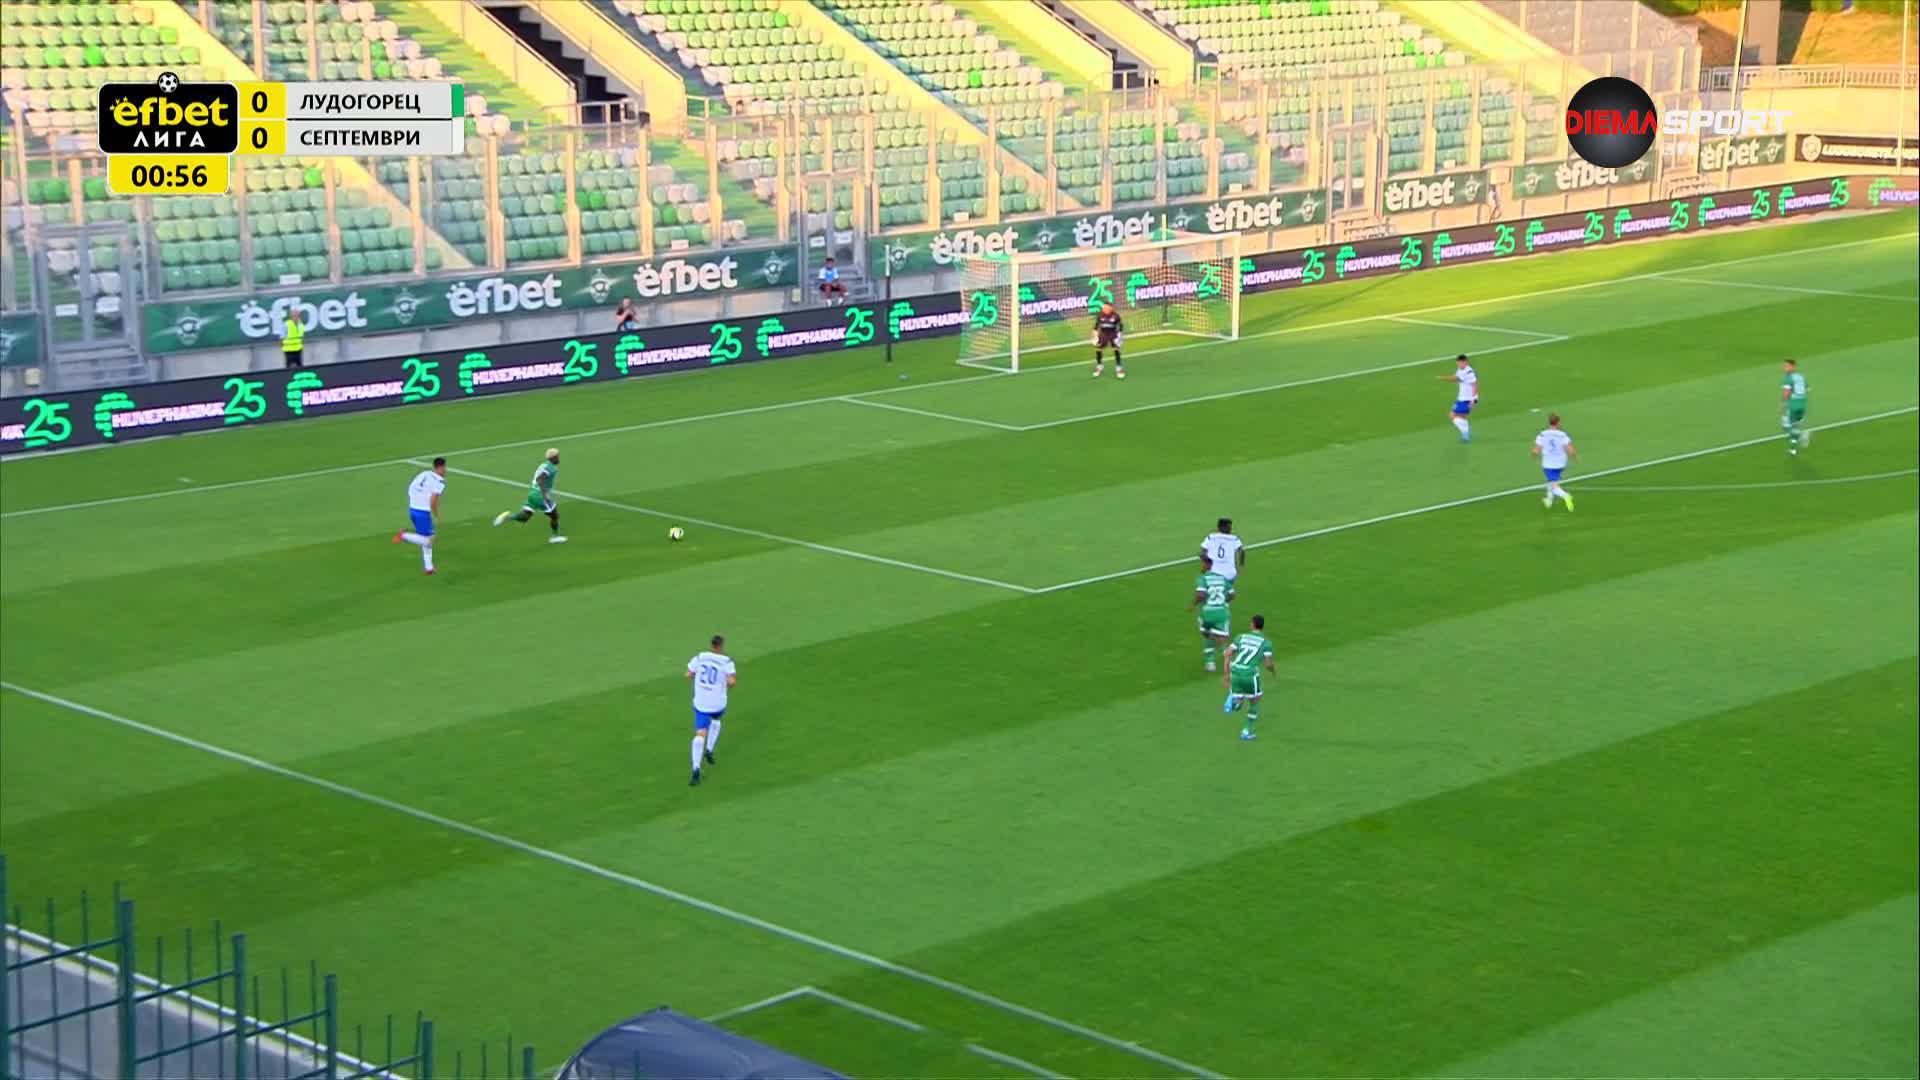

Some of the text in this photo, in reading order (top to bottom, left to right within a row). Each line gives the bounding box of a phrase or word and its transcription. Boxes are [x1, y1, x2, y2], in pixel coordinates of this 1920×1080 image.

[1385, 176, 1456, 212] efbet
[1752, 190, 1771, 217] 25
[1830, 178, 1848, 206] 25
[1072, 211, 1155, 248] efbet
[1205, 196, 1283, 233] efbet
[1584, 212, 1605, 240] 25
[1671, 201, 1689, 228] 25
[930, 225, 1019, 265] efbet
[1401, 237, 1422, 267] 25
[1494, 225, 1515, 253] 25
[634, 255, 738, 298] efbet
[1198, 263, 1222, 295] 25
[1303, 250, 1325, 280] 25
[447, 272, 563, 317] efbet
[970, 291, 999, 326] 25
[1088, 277, 1113, 308] 25
[237, 291, 368, 339] efbet
[768, 308, 875, 349] HUVEPHARMA 25
[563, 340, 598, 377] 25
[711, 323, 742, 359] 25
[402, 358, 441, 397] 25
[224, 378, 266, 418] 25
[23, 399, 72, 442] 25
[1231, 644, 1259, 665] 77
[699, 663, 719, 686] 20
